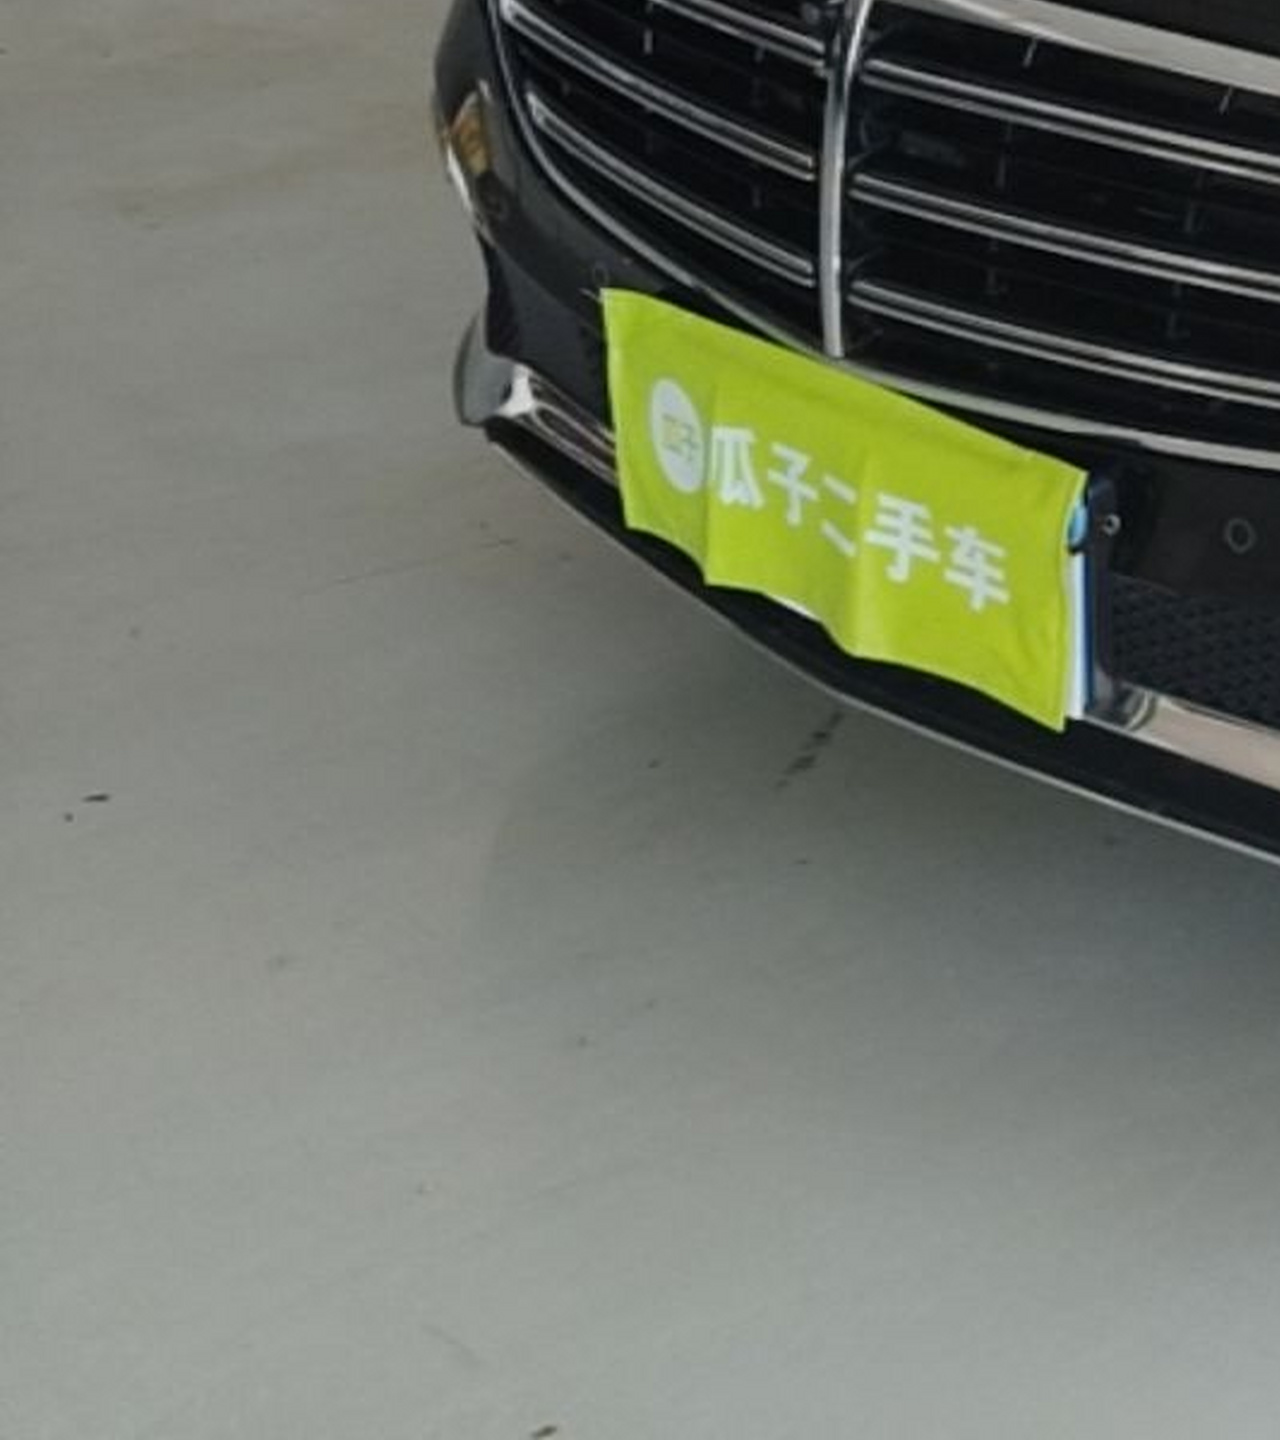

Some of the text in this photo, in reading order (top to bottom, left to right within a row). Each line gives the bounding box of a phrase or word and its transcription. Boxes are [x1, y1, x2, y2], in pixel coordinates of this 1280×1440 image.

[712, 425, 1010, 613] 瓜子二手车
